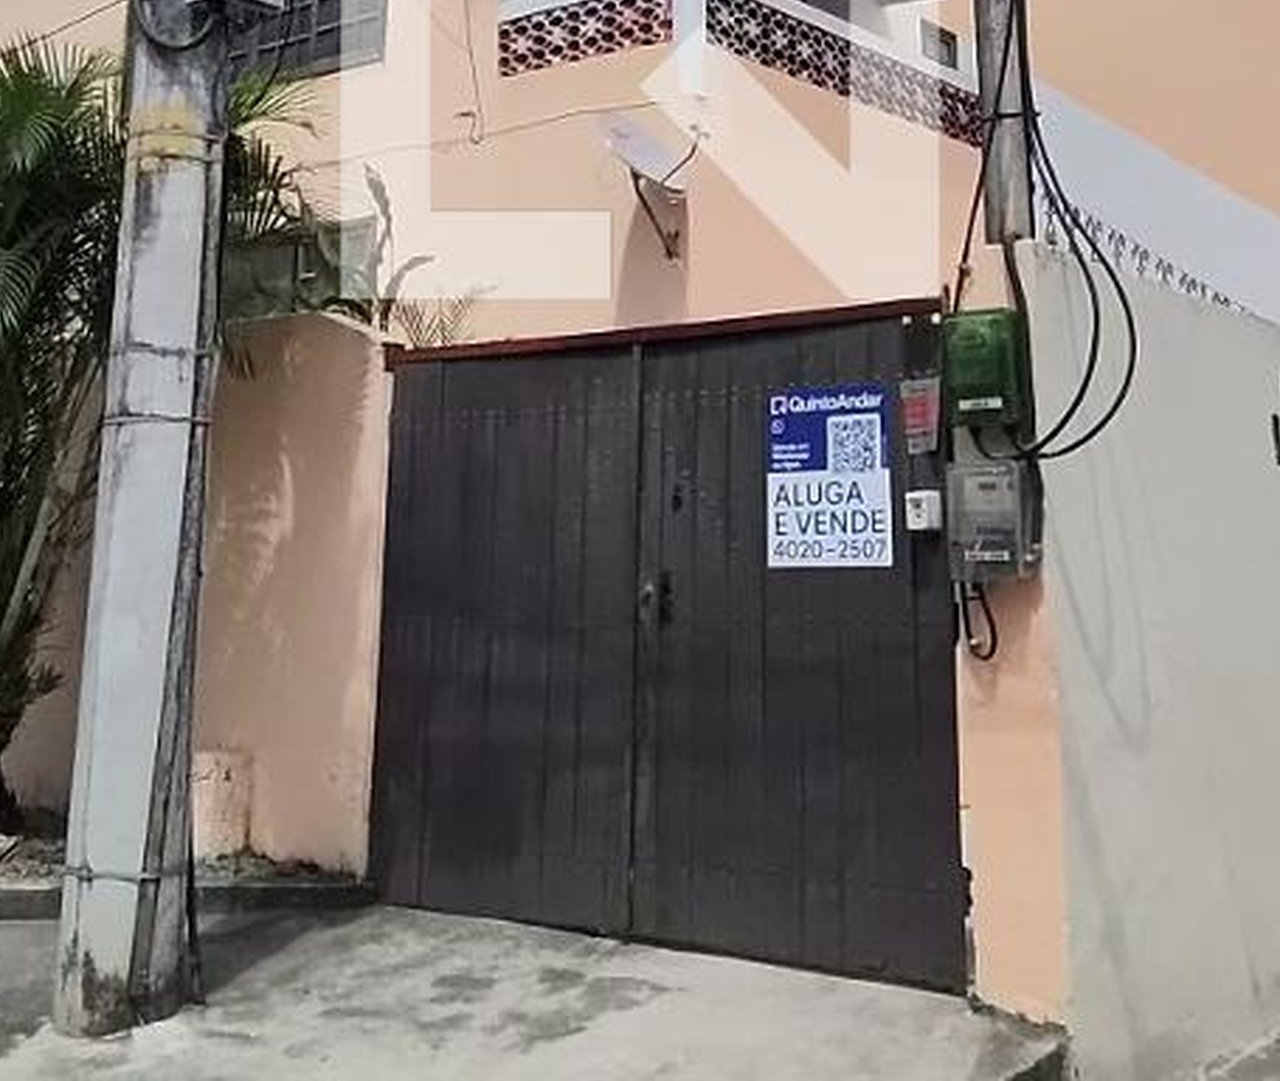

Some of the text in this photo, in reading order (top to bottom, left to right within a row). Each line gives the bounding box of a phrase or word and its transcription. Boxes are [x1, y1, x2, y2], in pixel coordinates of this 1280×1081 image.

[789, 392, 882, 413] QuintoAndar
[773, 480, 865, 508] ALUGA
[775, 508, 886, 536] E VENDE
[773, 539, 886, 559] 4020-2507
